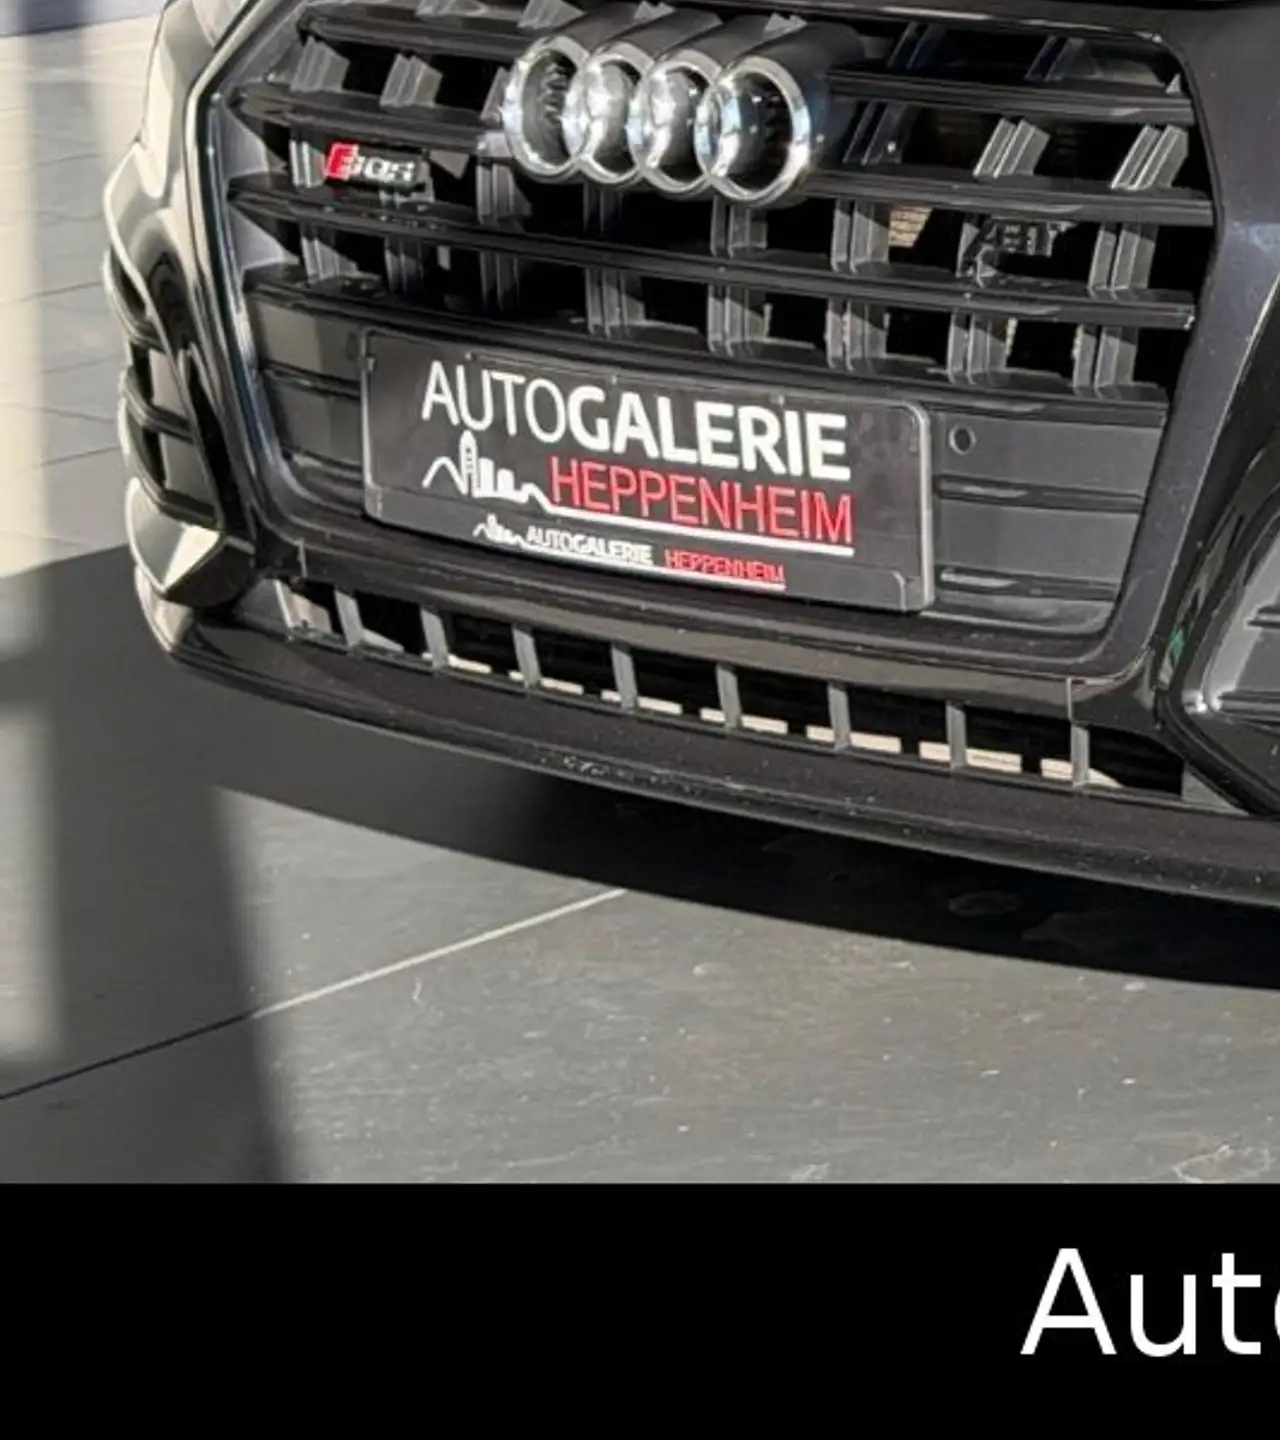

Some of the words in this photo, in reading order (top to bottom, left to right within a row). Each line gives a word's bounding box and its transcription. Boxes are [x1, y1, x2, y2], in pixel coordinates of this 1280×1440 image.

[422, 361, 851, 481] AUTOGALERIE
[549, 456, 855, 544] HEPPENHEIM
[526, 524, 655, 566] AUTOGALERIE
[664, 548, 787, 583] HEPPENHEIM
